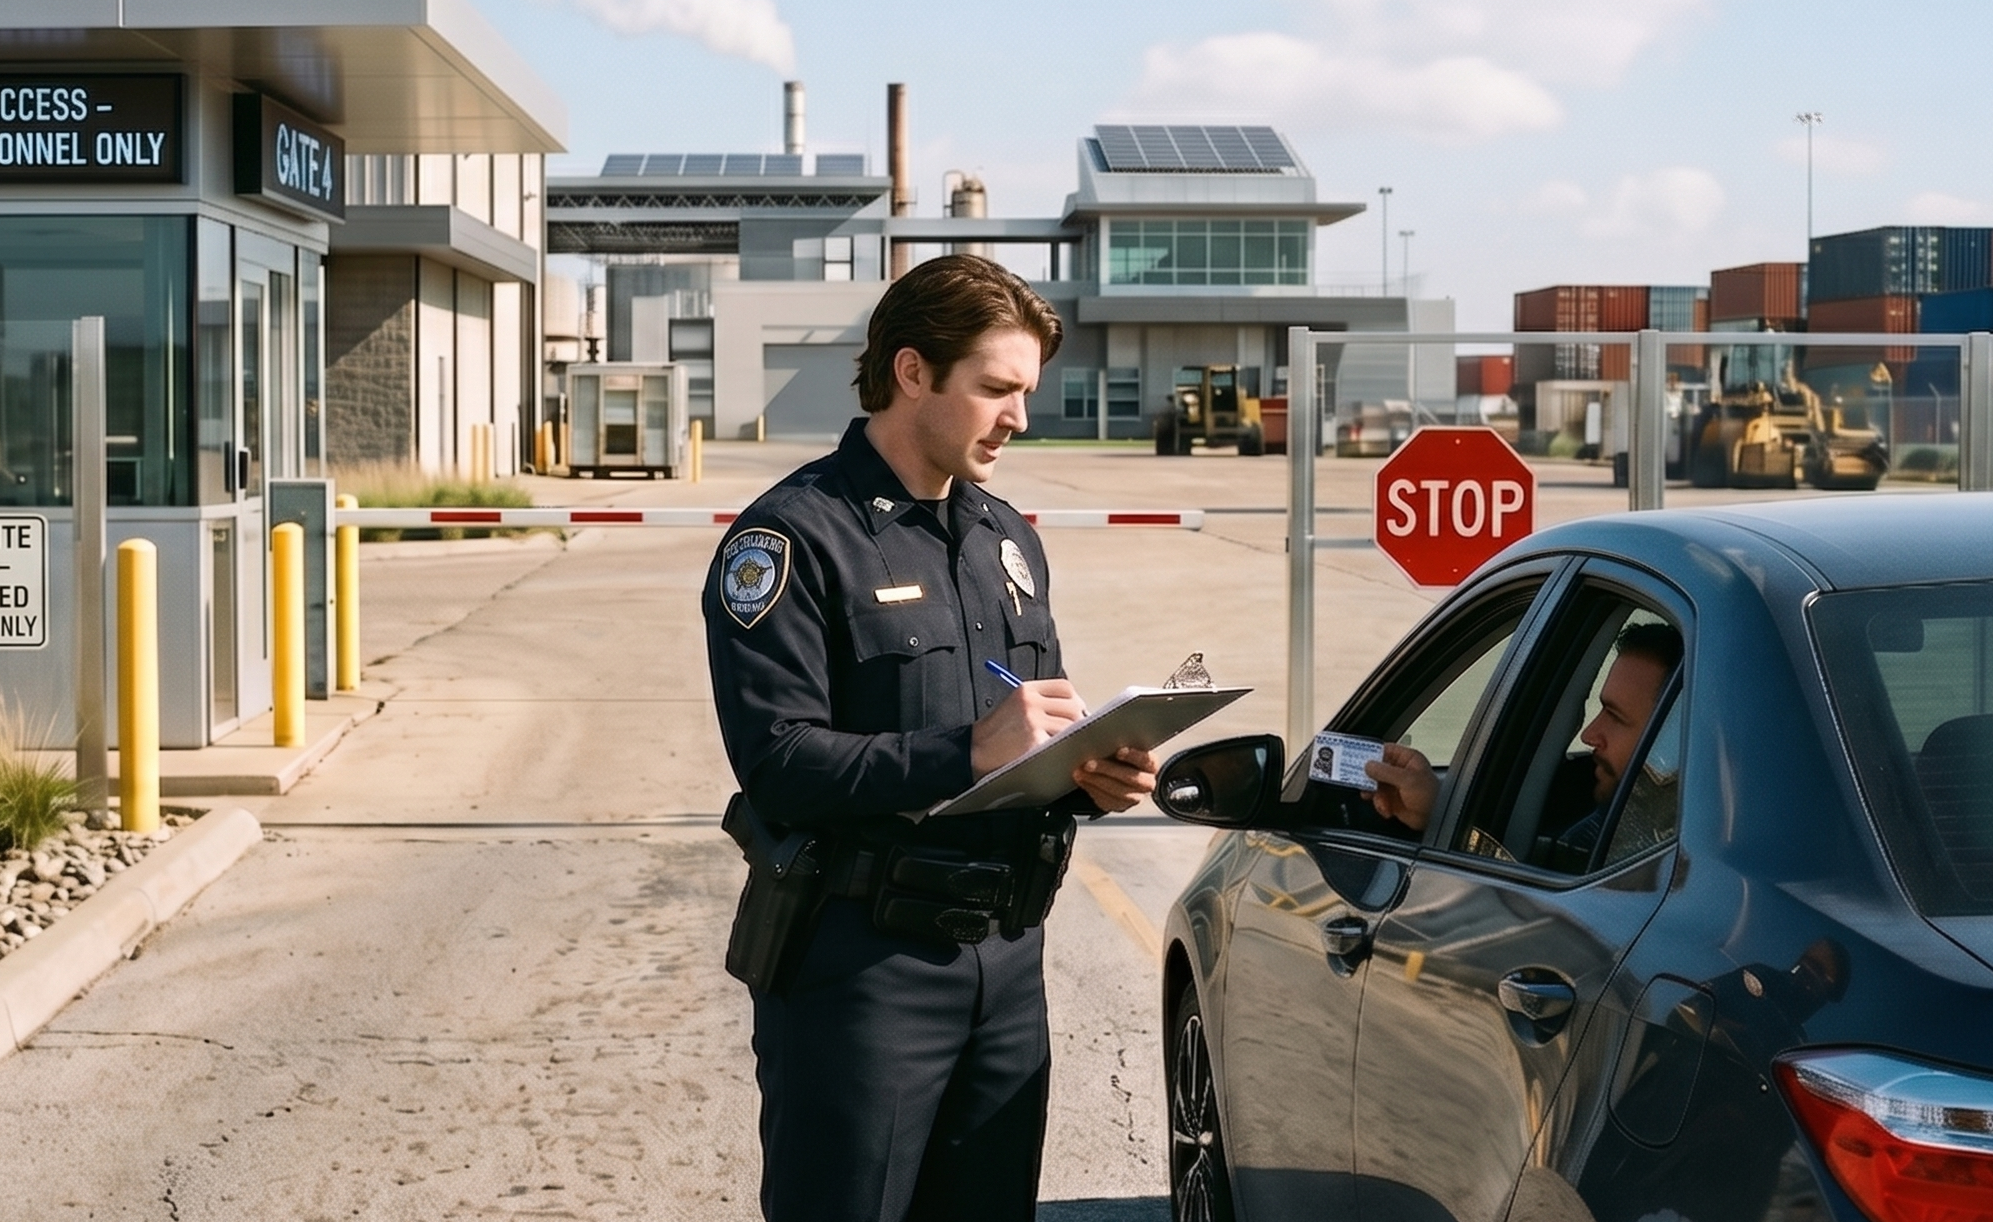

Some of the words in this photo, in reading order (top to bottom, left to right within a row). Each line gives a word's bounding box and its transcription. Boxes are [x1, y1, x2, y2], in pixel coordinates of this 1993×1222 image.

[1, 87, 87, 121] CCESS
[0, 132, 87, 165] ONNEL
[96, 132, 165, 165] ONLY
[276, 123, 321, 198] GATE
[321, 145, 333, 201] 4
[1386, 478, 1525, 538] STOP
[2, 525, 31, 549] TE
[0, 585, 29, 608] ED
[1, 615, 38, 637] NLY
